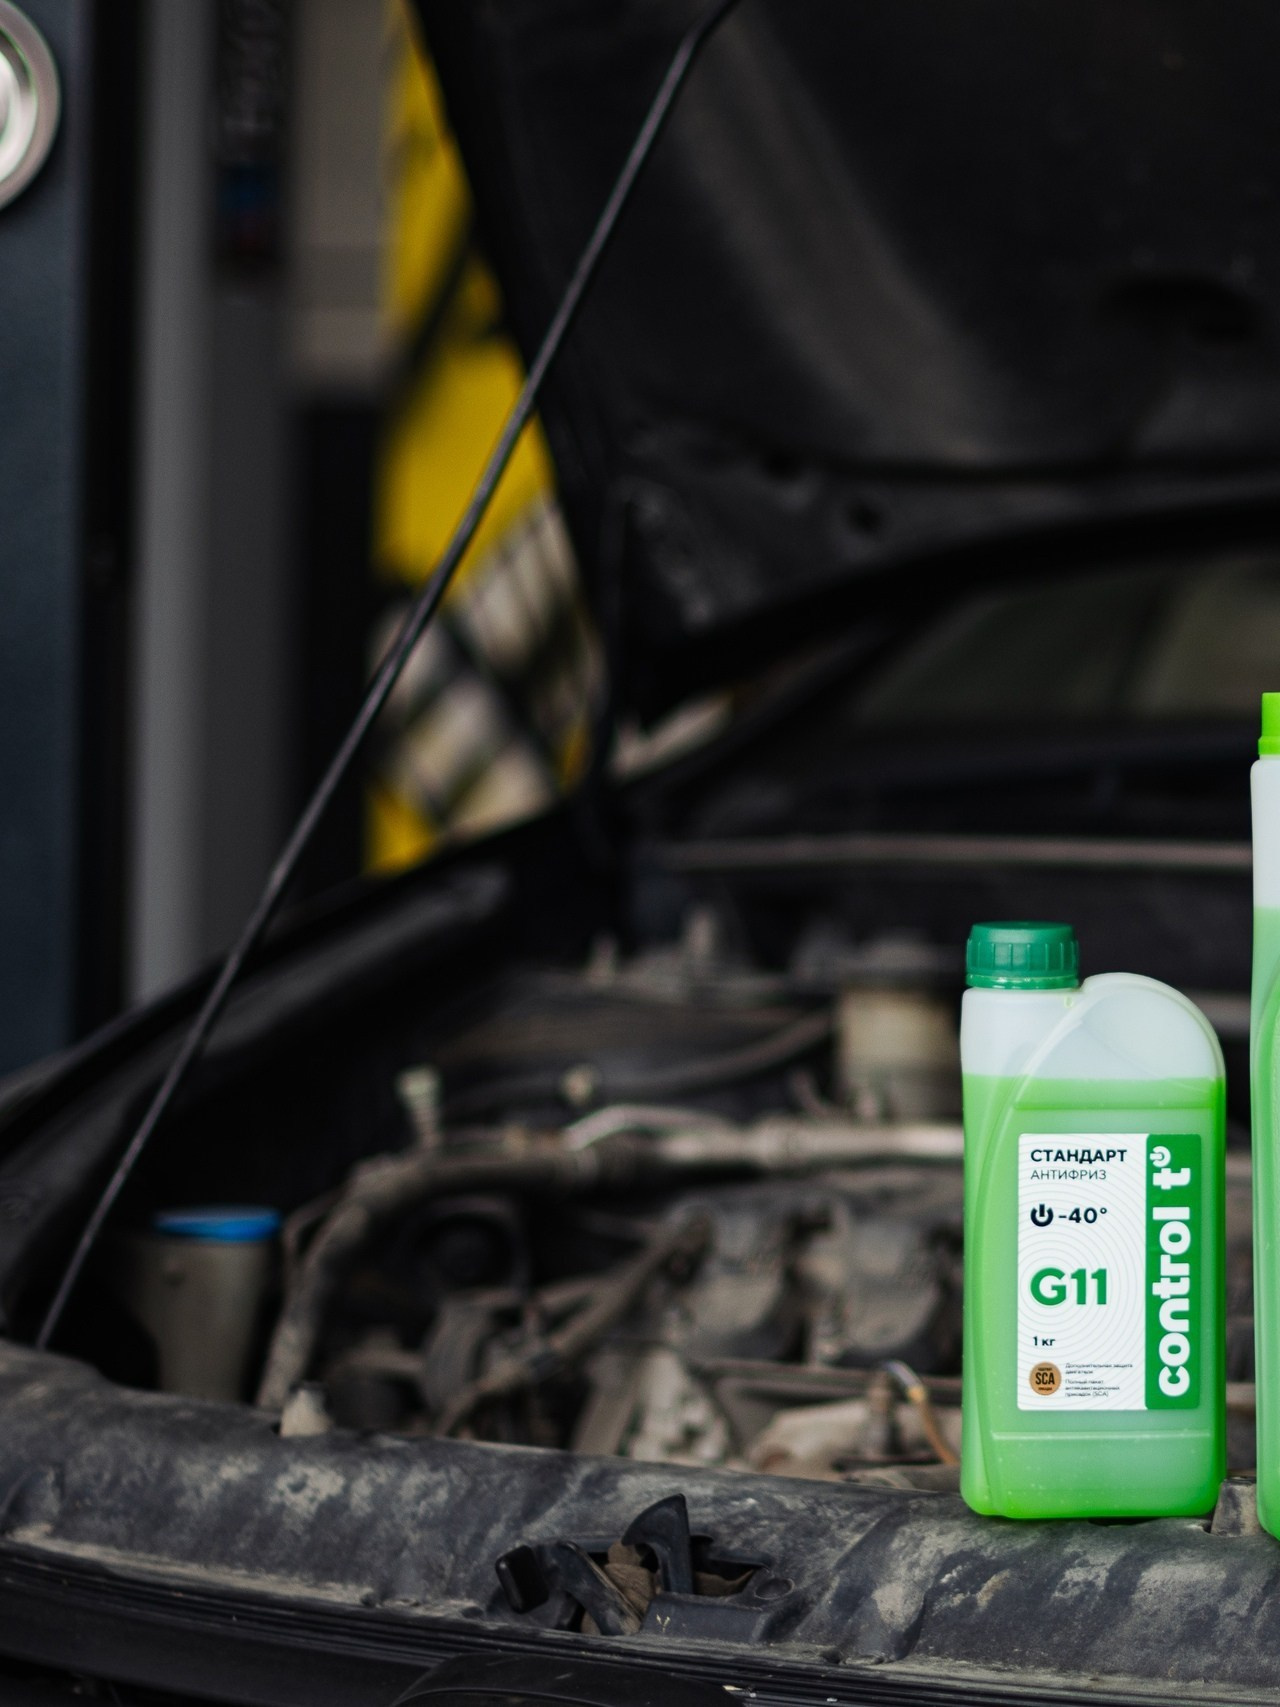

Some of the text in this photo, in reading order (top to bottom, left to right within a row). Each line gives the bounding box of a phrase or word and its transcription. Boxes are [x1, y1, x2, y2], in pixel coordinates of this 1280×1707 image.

[1030, 1149, 1128, 1164] СТАНДАРТ
[1030, 1169, 1107, 1180] АНТИФРИЗ
[1058, 1207, 1108, 1224] -40°
[1030, 1267, 1107, 1307] G11
[1152, 1206, 1191, 1397] control
[1033, 1336, 1038, 1346] 1
[1035, 1372, 1055, 1385] SCA
